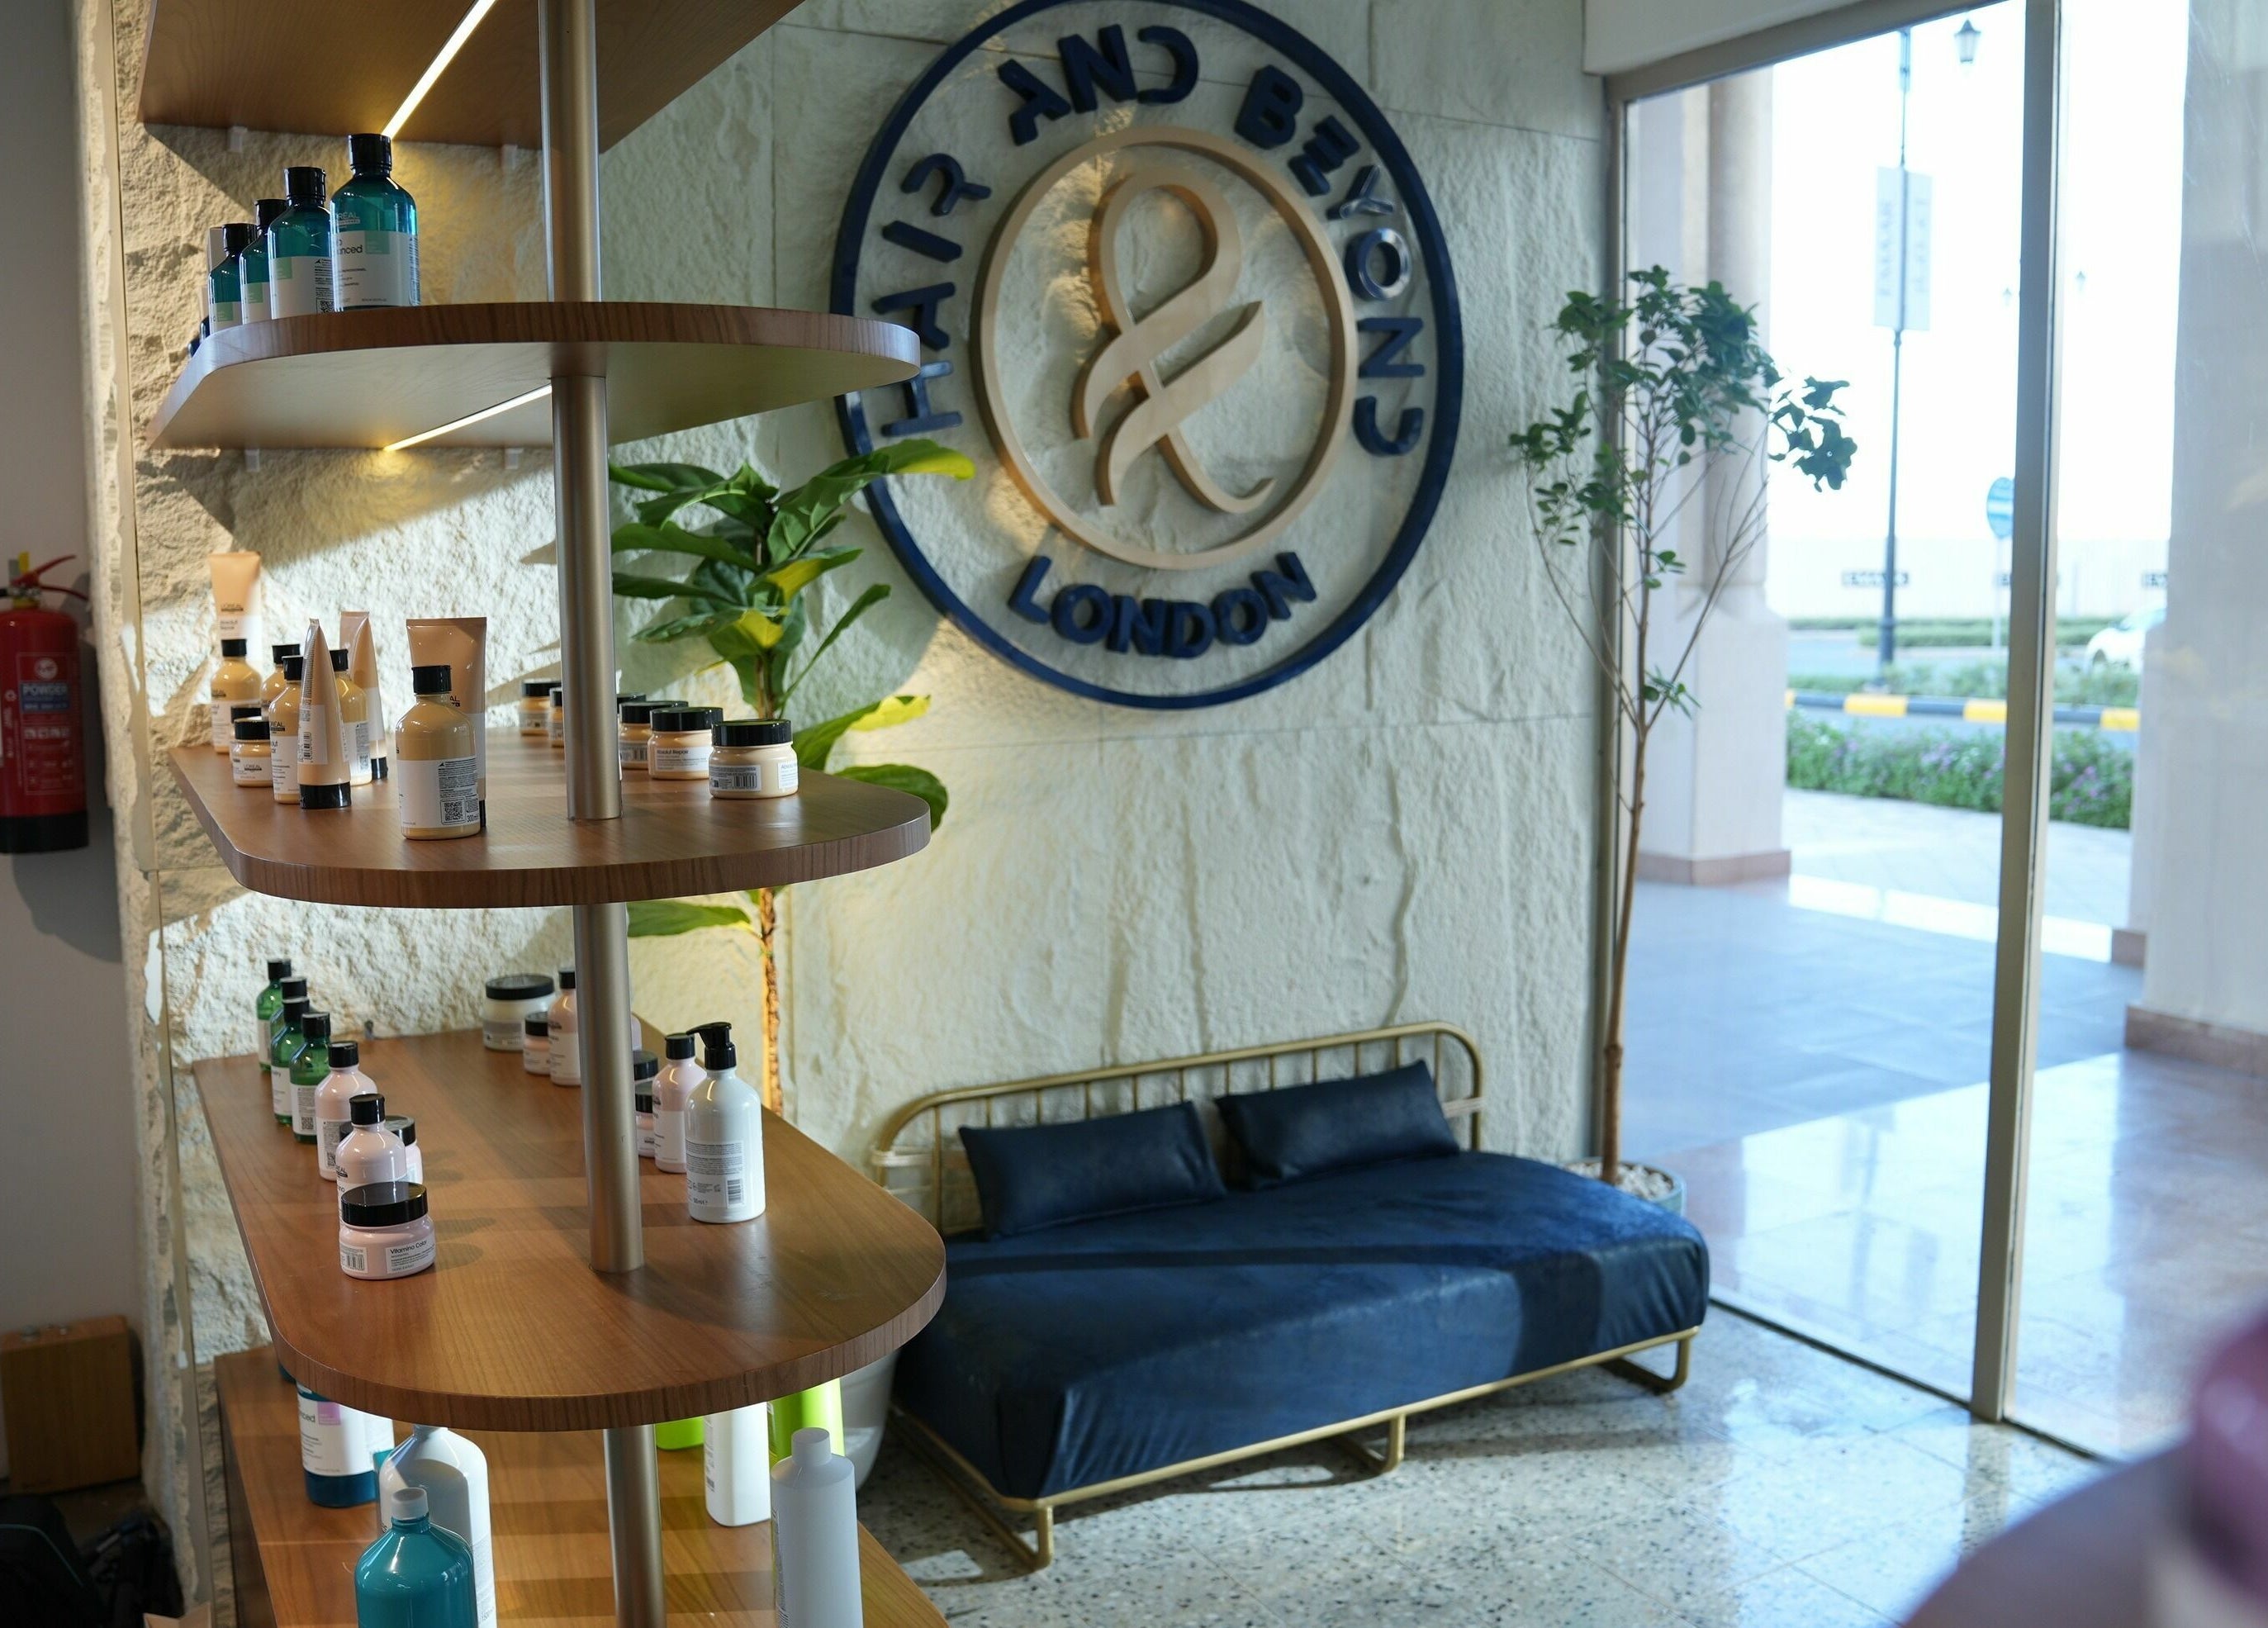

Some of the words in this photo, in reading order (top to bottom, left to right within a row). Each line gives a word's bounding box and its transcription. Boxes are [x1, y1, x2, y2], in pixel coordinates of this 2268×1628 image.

[871, 152, 992, 439] HAIR
[998, 23, 1200, 147] AND
[1234, 64, 1427, 458] BEYOND
[1007, 549, 1318, 660] LONDON
[390, 1245, 415, 1254] Vitamino
